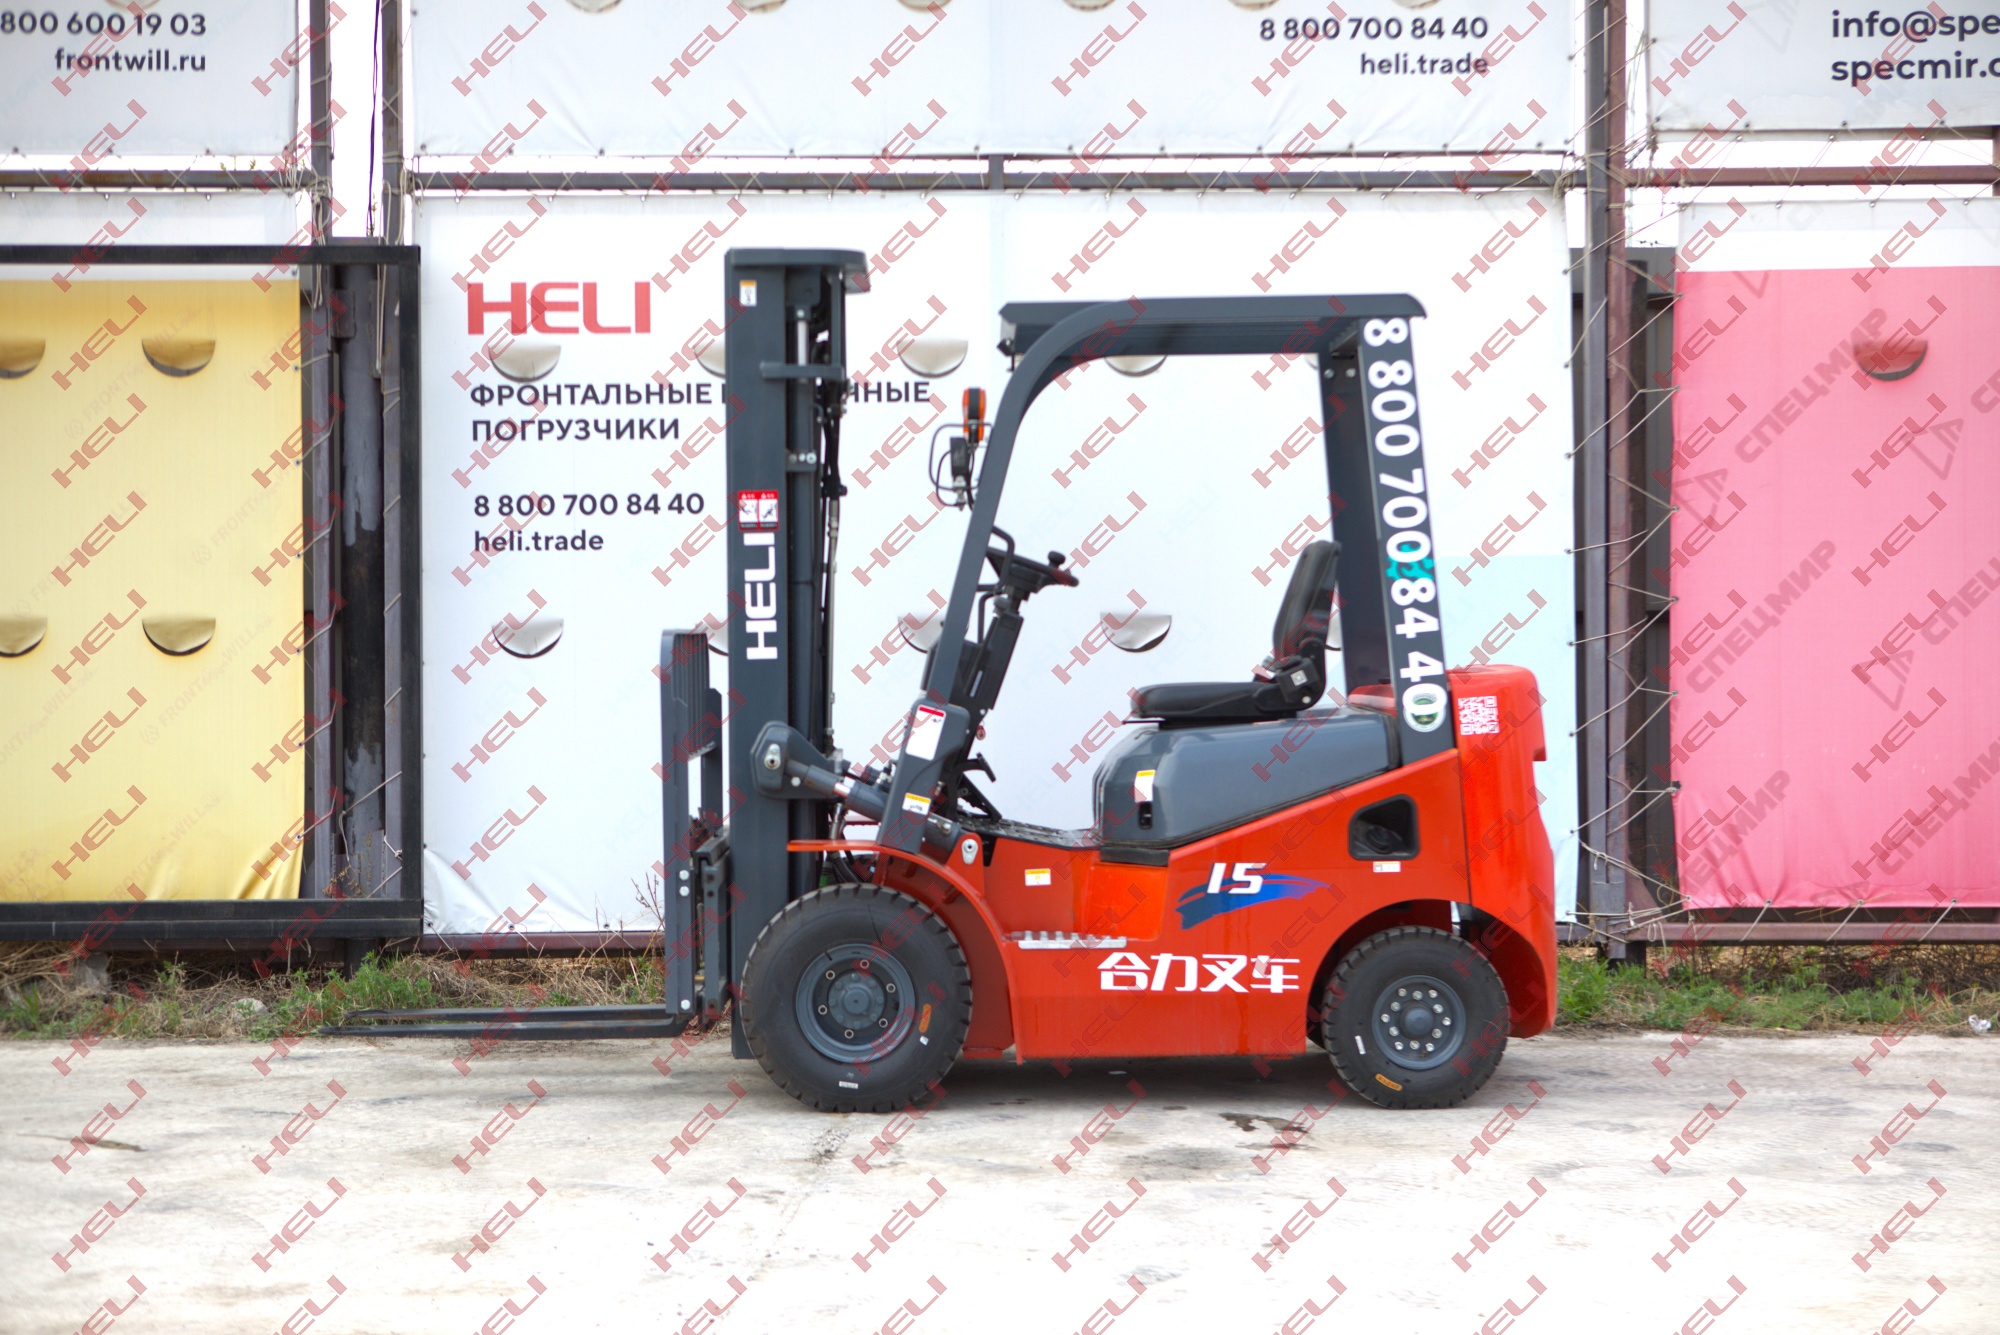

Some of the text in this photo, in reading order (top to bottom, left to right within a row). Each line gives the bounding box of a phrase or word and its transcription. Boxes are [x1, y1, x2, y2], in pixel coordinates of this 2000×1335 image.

[0, 11, 206, 36] 800 600 19 03
[1260, 17, 1488, 40] 8 800 700 84 40
[1832, 10, 2000, 43] info@spe
[55, 48, 206, 71] frontwill.ru
[1361, 53, 1488, 74] heli.trade
[467, 281, 651, 335] HELI
[1364, 318, 1409, 347] 8
[470, 383, 712, 407] ФРОНТАЛЬНЫЕ
[1734, 308, 1887, 463] СПЕЦМИР
[1368, 359, 1421, 457] 800
[472, 419, 679, 441] ПОГРУЗЧИКИ
[474, 493, 704, 517] 8 800 700 84 40
[1379, 468, 1432, 563] 700
[475, 529, 604, 552] heli.trade
[743, 532, 778, 660] HELI
[1391, 577, 1440, 639] 84
[1686, 540, 1837, 693] СПЕЦМИР
[1400, 651, 1448, 718] 40
[1207, 862, 1267, 894] 15
[1097, 952, 1301, 994] 合力叉车
